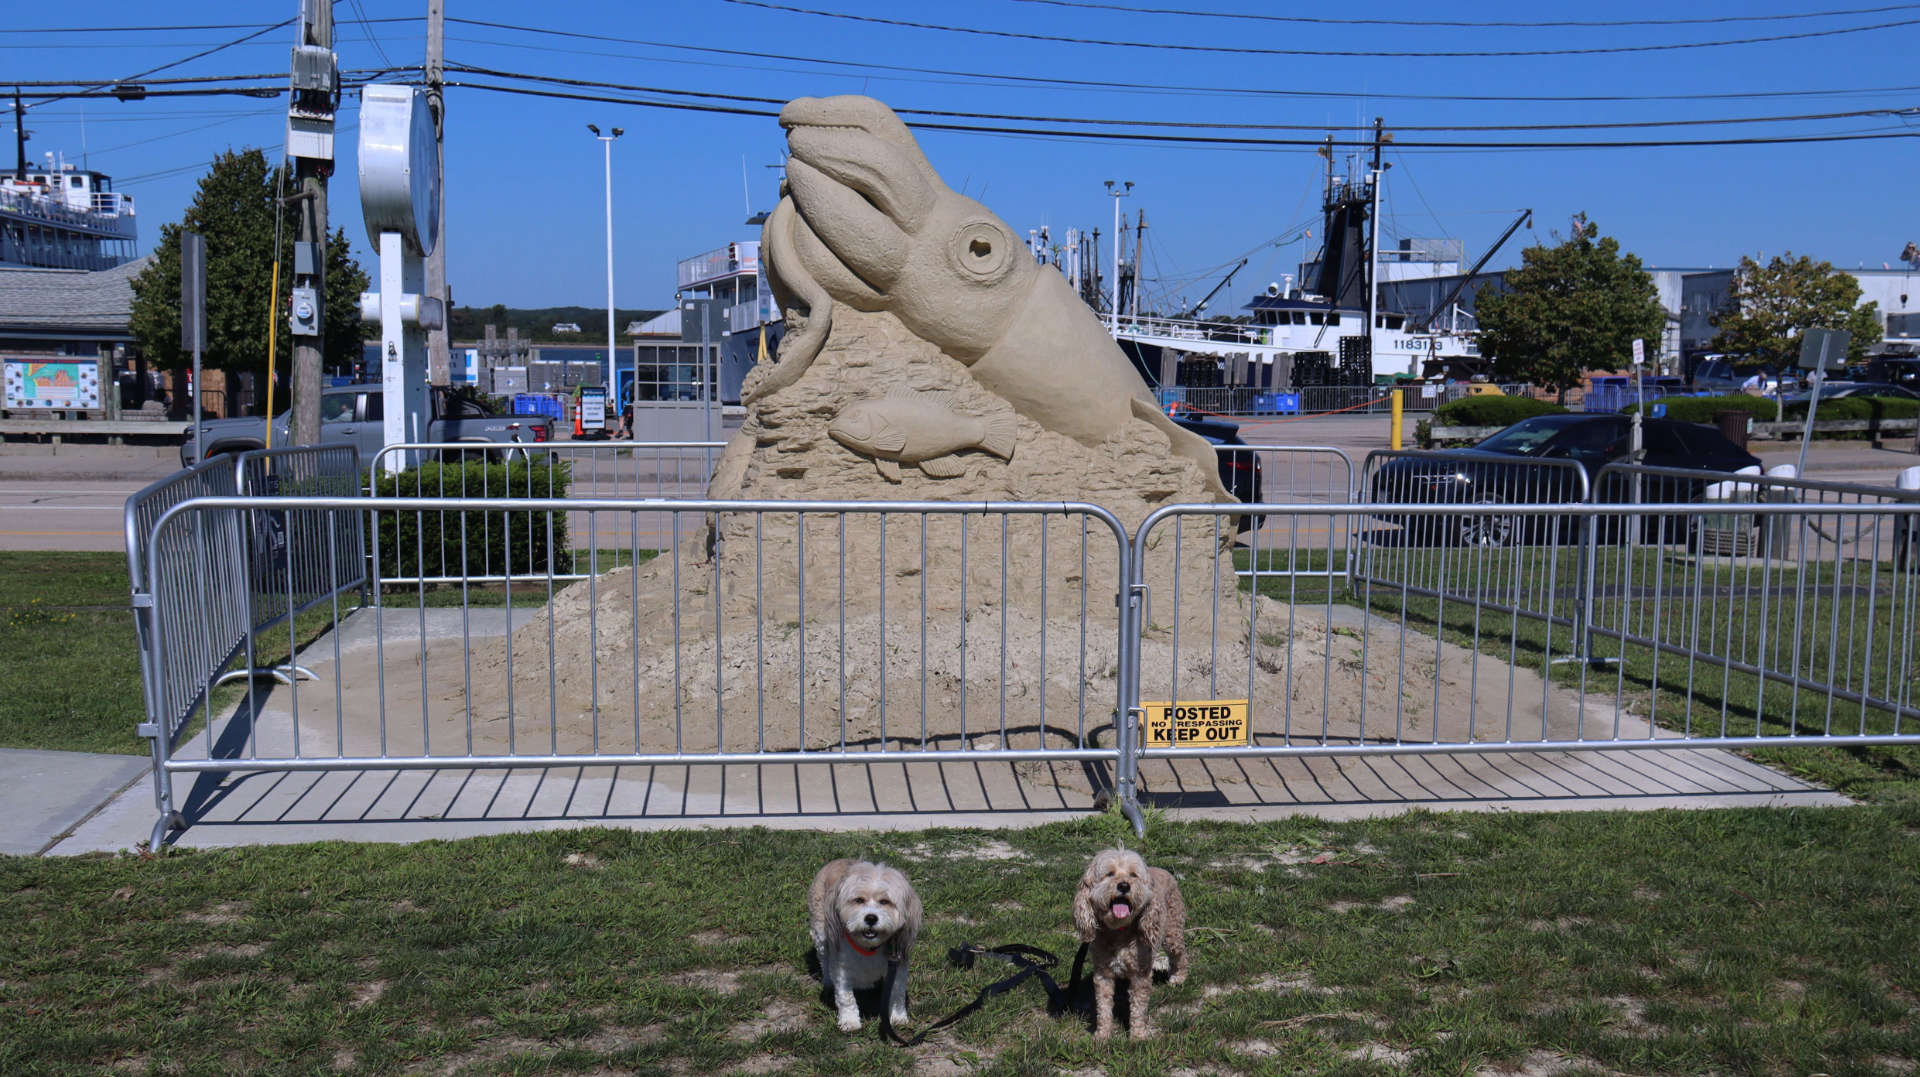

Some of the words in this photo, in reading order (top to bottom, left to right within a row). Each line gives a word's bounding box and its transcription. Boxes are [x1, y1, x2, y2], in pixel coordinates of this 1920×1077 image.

[1394, 339, 1443, 351] 118313
[1163, 706, 1231, 720] POSTED
[1174, 719, 1243, 727] RESPASSING
[1153, 728, 1200, 741] KEEP
[1206, 726, 1240, 740] OUT
